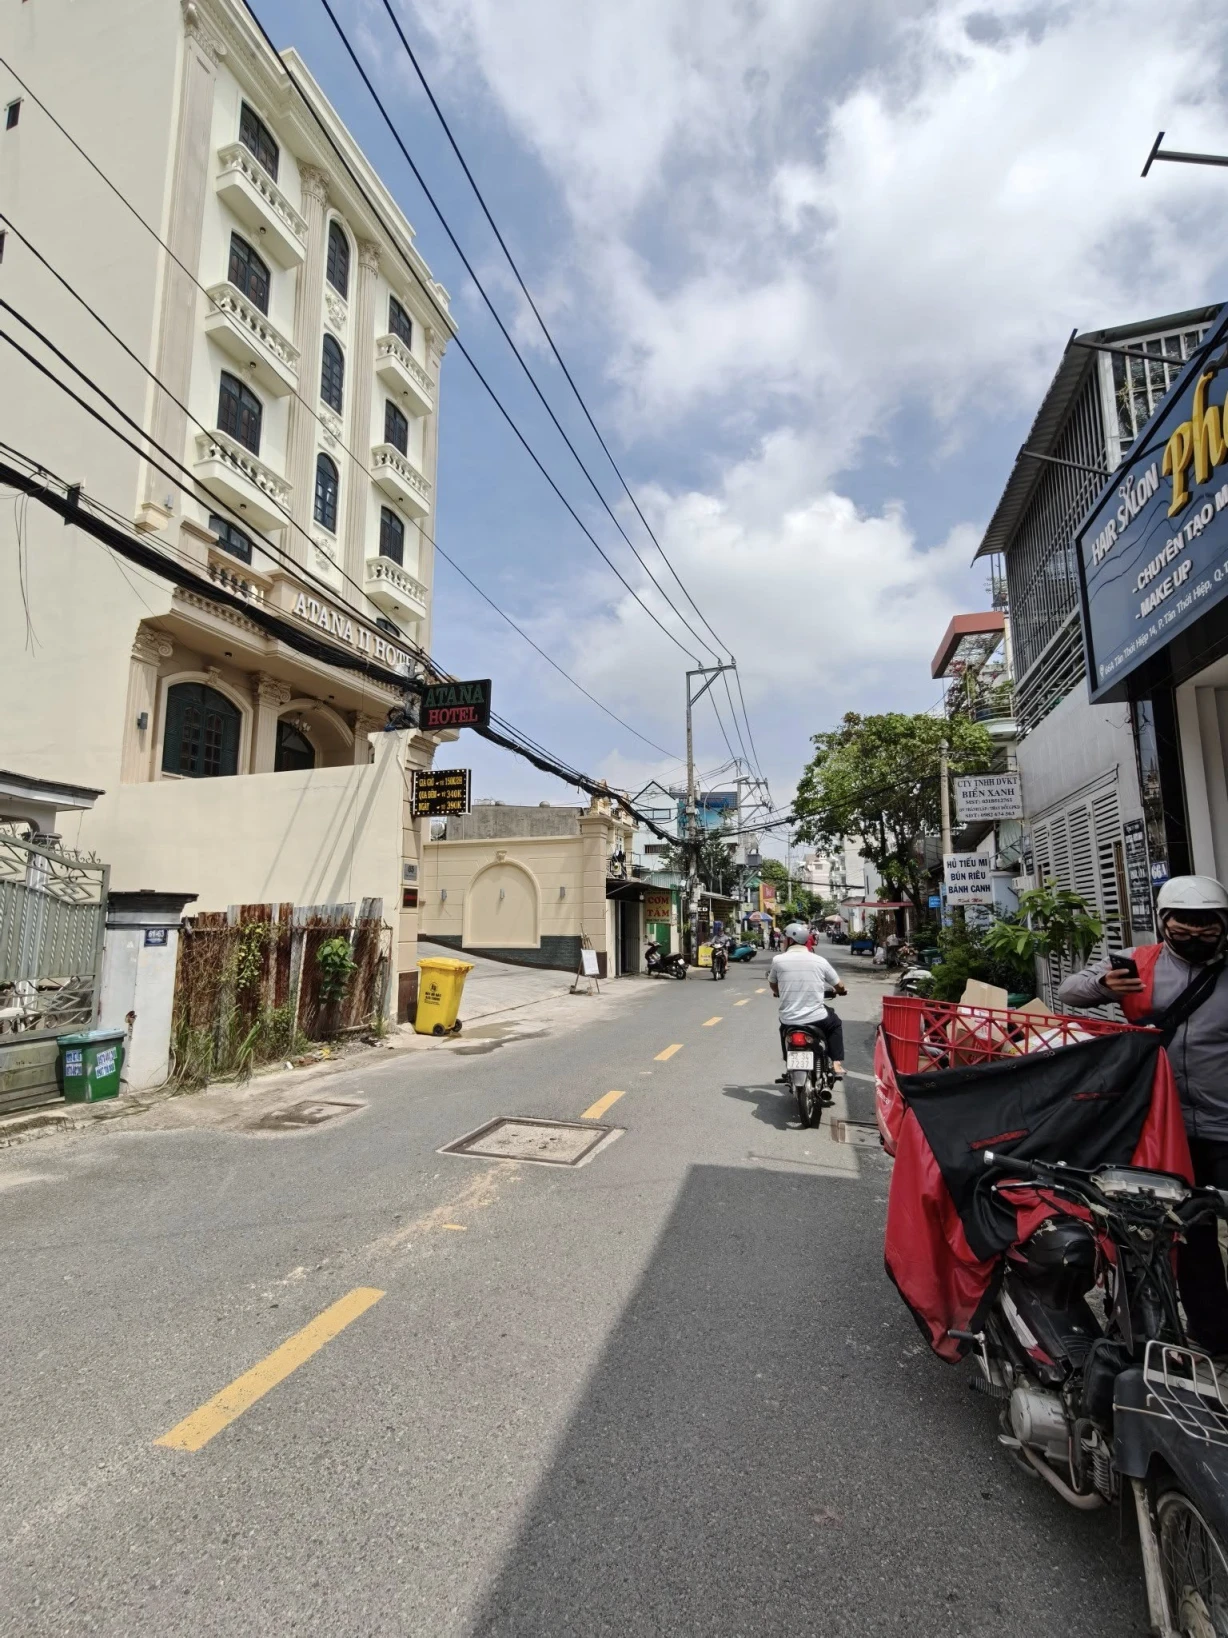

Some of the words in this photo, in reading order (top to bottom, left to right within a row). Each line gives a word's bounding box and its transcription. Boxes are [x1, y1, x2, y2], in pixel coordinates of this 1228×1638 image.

[1184, 503, 1214, 541] TẠO
[1091, 519, 1118, 566] HAIR
[1173, 559, 1192, 587] UP
[292, 592, 354, 645] ATANA
[357, 626, 371, 653] II
[423, 684, 484, 708] ATANA
[428, 706, 479, 726] HOTEL
[958, 780, 973, 788] CTY
[973, 778, 995, 787] TNHH
[997, 777, 1018, 786] DVKT
[446, 789, 462, 799] 340K
[962, 786, 985, 799] BIỂN
[988, 788, 1015, 798] XANH
[446, 800, 462, 810] 390K
[947, 858, 957, 868] HỦ
[959, 857, 976, 868] TIẾU
[951, 871, 966, 881] BÚN
[968, 870, 986, 881] RIÊU
[948, 884, 969, 894] BÁNH
[970, 884, 991, 893] CANH
[148, 929, 164, 938] 61-63
